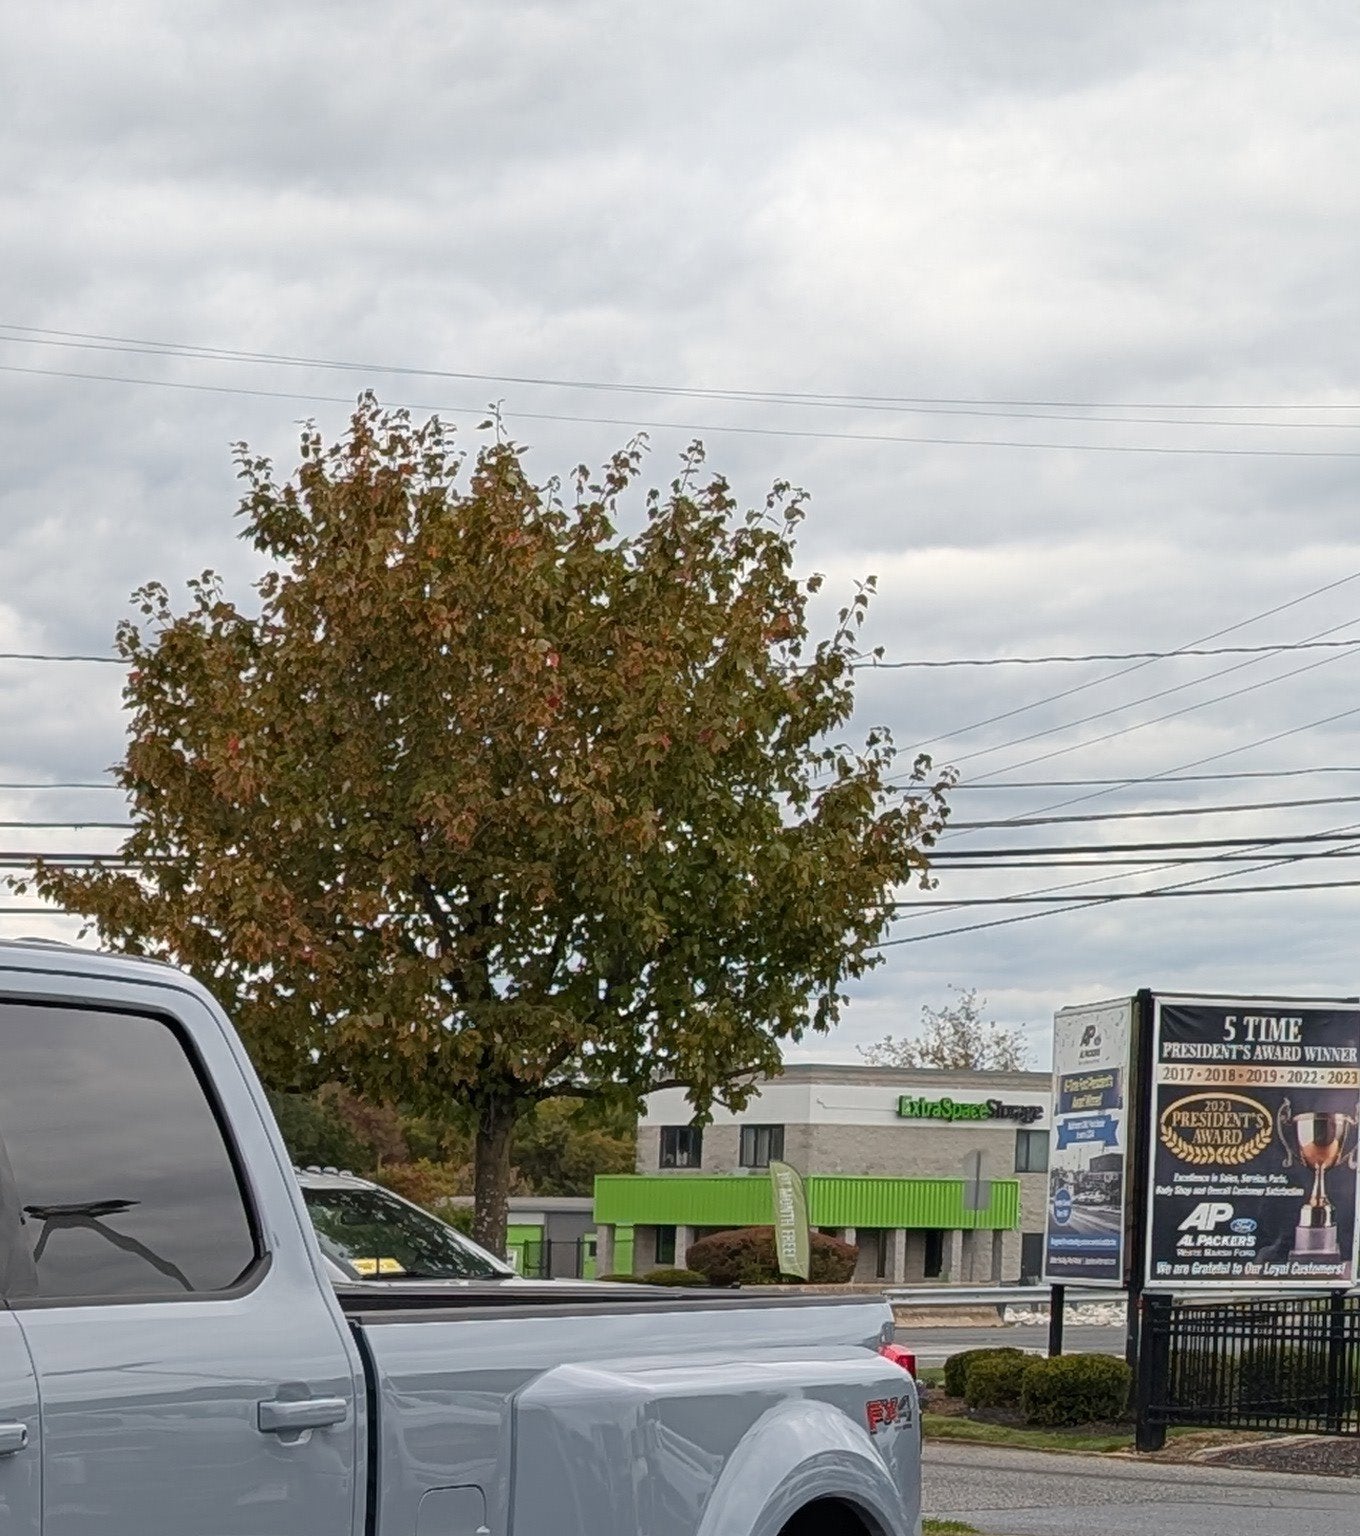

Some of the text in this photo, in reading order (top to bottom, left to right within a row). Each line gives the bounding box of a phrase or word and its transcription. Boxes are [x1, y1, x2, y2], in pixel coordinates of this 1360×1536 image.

[1222, 1016, 1303, 1043] 5 TIME
[1163, 1042, 1358, 1062] PRESIDENT'S AWARD WINNER
[1163, 1066, 1193, 1081] 2017
[1205, 1067, 1236, 1082] 2018
[1246, 1069, 1278, 1083] 2019
[1287, 1070, 1318, 1084] 2022
[1172, 1112, 1264, 1128] PRESIDENT'S
[1192, 1129, 1243, 1145] AWARD
[1177, 1202, 1234, 1231] AP
[1177, 1235, 1195, 1247] AL
